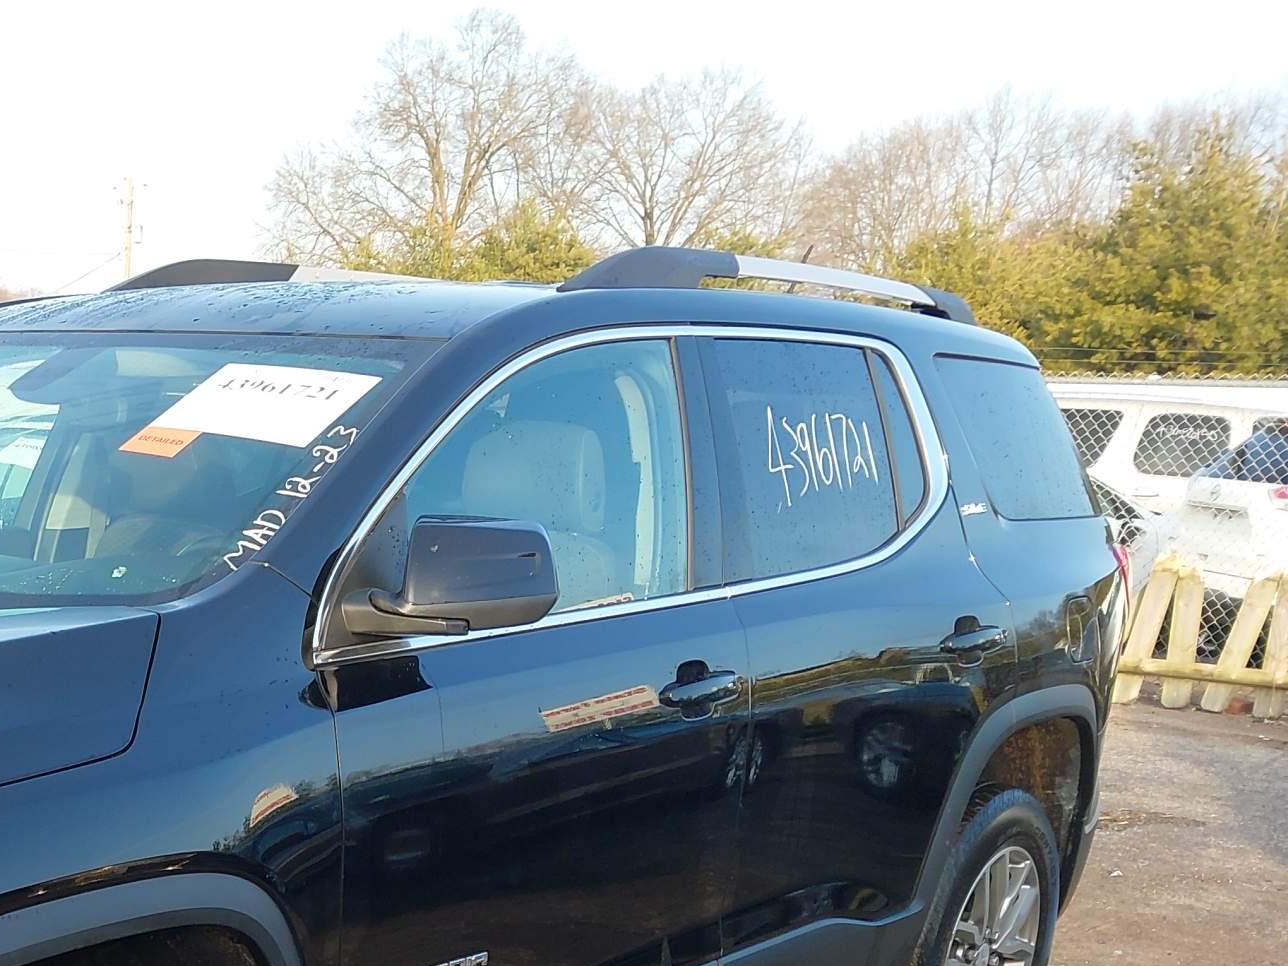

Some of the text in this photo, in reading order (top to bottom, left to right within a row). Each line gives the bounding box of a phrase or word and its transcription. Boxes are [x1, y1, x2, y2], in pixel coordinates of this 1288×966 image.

[223, 425, 360, 571] MAD 12-23
[767, 405, 879, 507] 43961721
